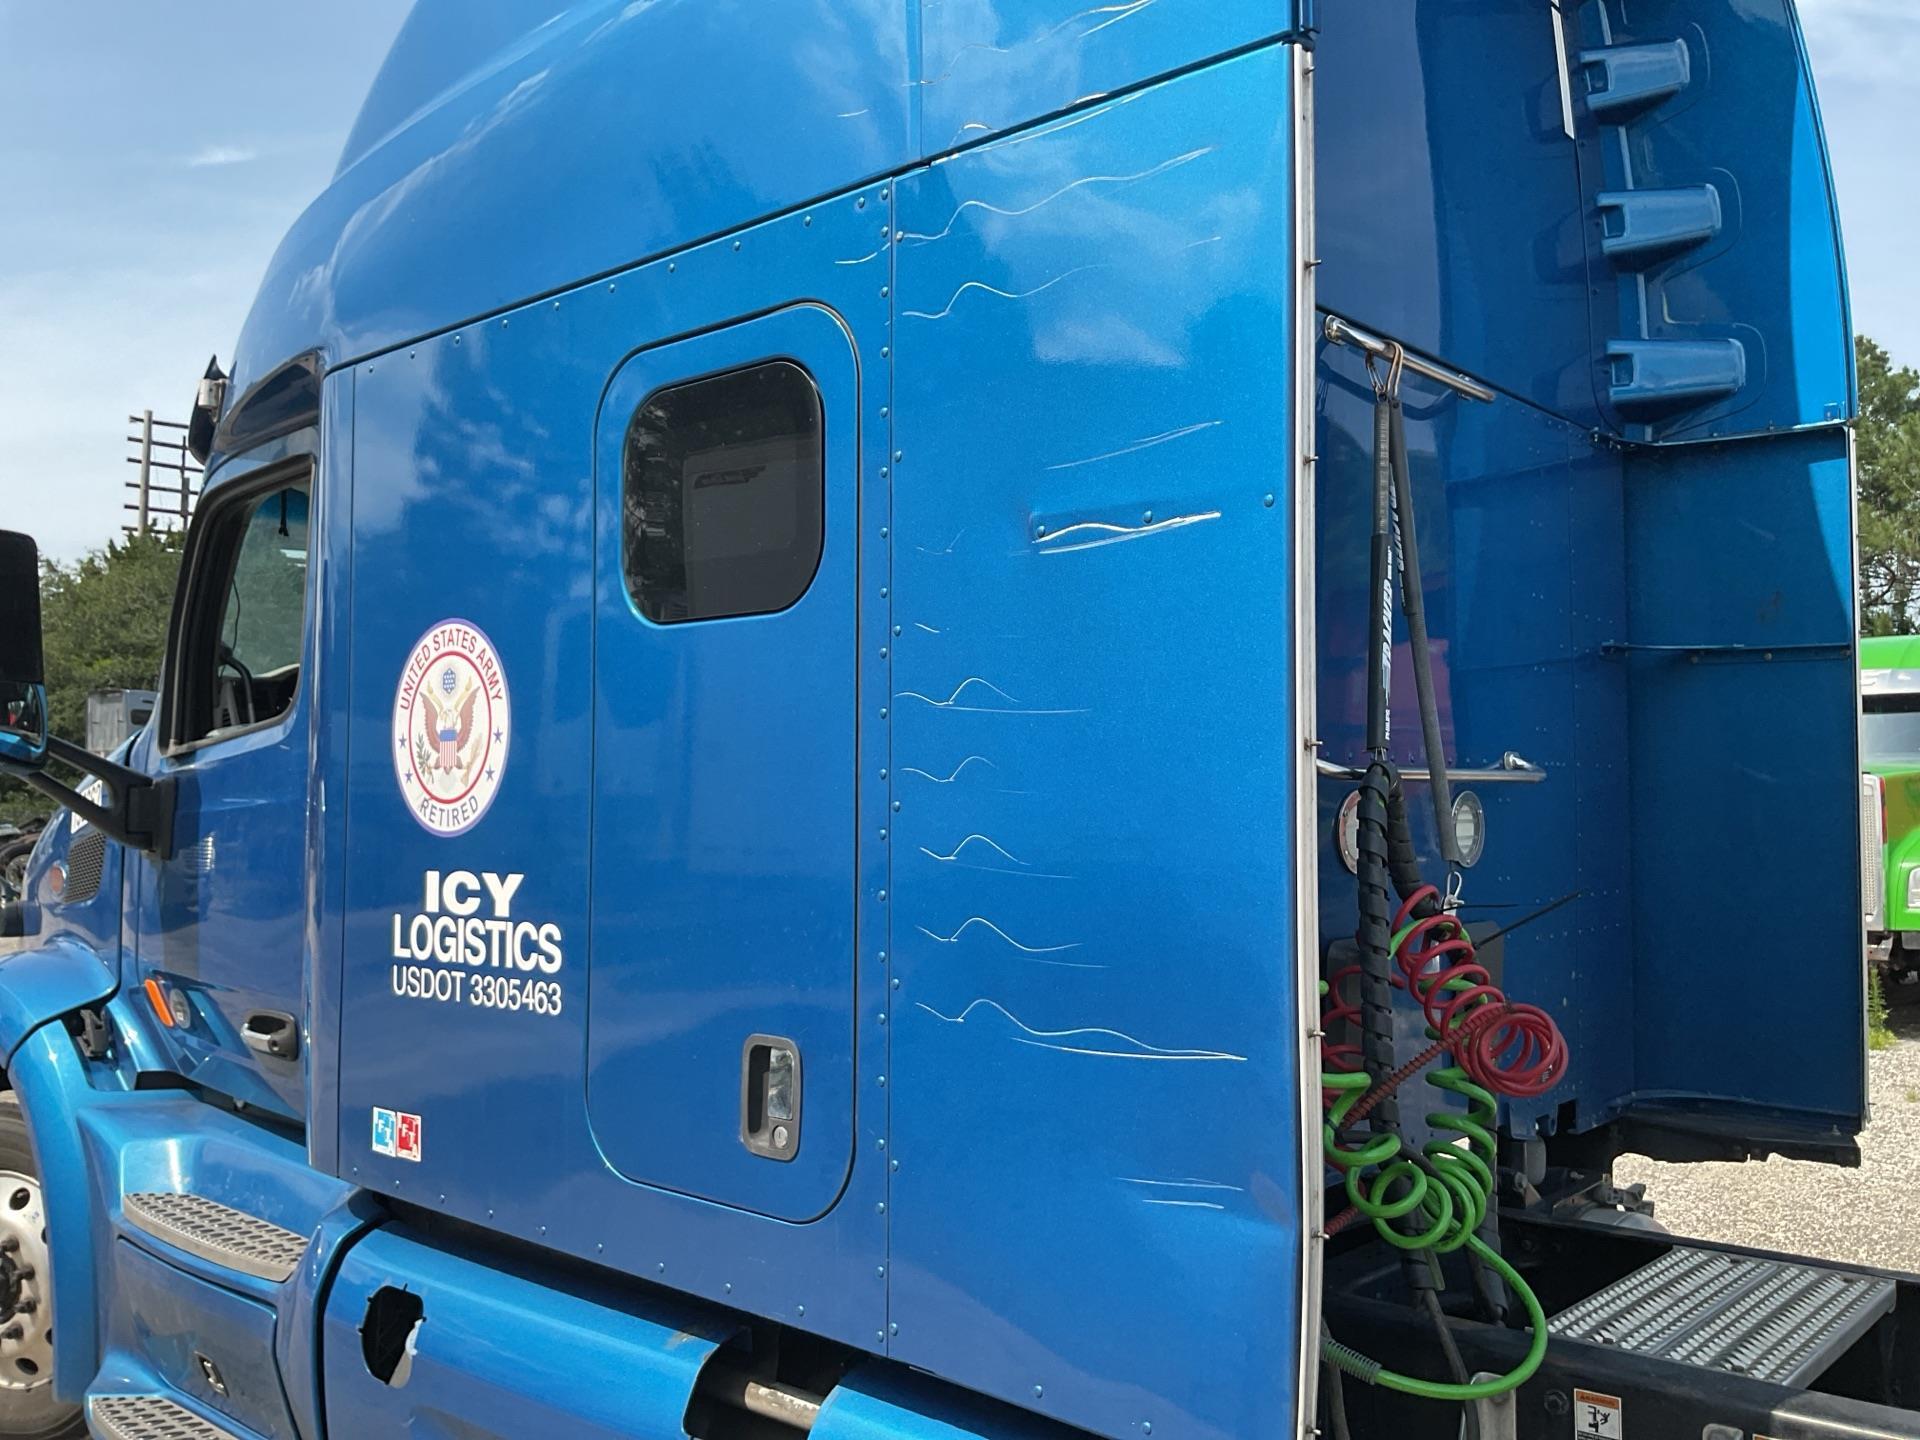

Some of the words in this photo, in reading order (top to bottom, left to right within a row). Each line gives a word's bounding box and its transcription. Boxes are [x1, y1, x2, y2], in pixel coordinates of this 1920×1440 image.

[400, 644, 431, 710] UNITED
[432, 628, 478, 653] STATES
[476, 649, 503, 702] ARMY
[419, 795, 479, 828] RETIRED
[425, 869, 525, 917] ICY
[392, 913, 563, 974] LOGISTICS
[391, 964, 466, 1003] USDOT
[469, 972, 563, 1016] 3305463
